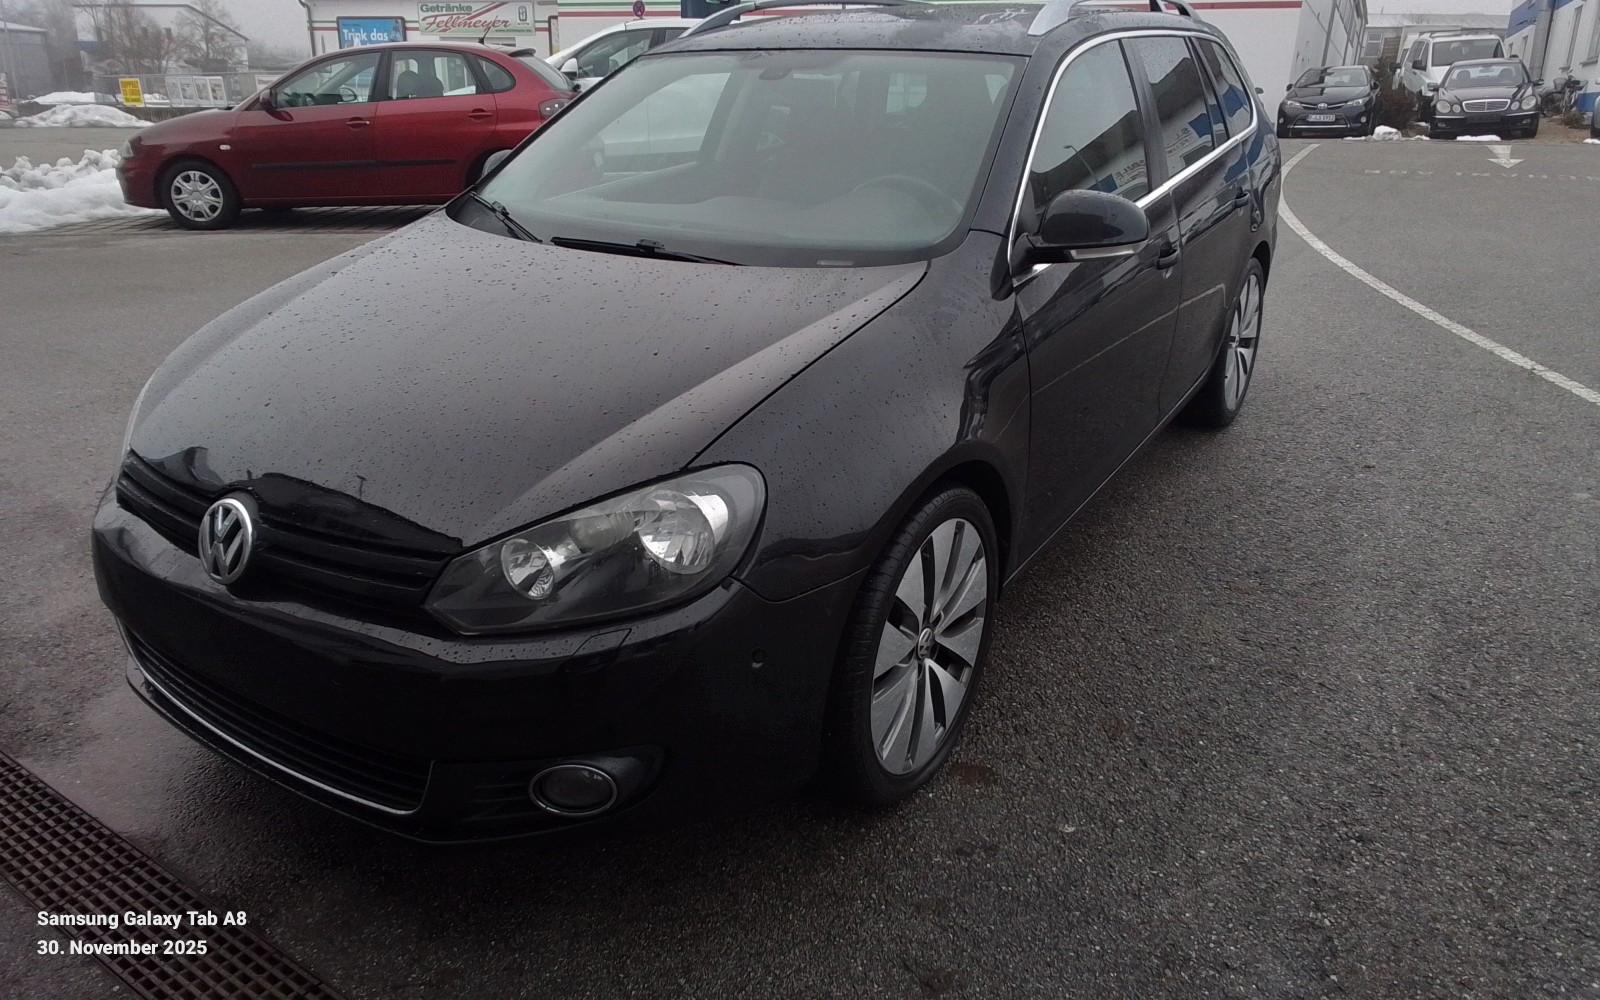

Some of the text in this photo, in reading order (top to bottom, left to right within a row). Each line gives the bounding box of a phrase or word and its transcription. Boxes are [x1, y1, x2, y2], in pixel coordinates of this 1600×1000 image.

[420, 4, 472, 13] Getränke
[422, 13, 511, 32] Fellmeyer
[343, 28, 389, 41] Trink das
